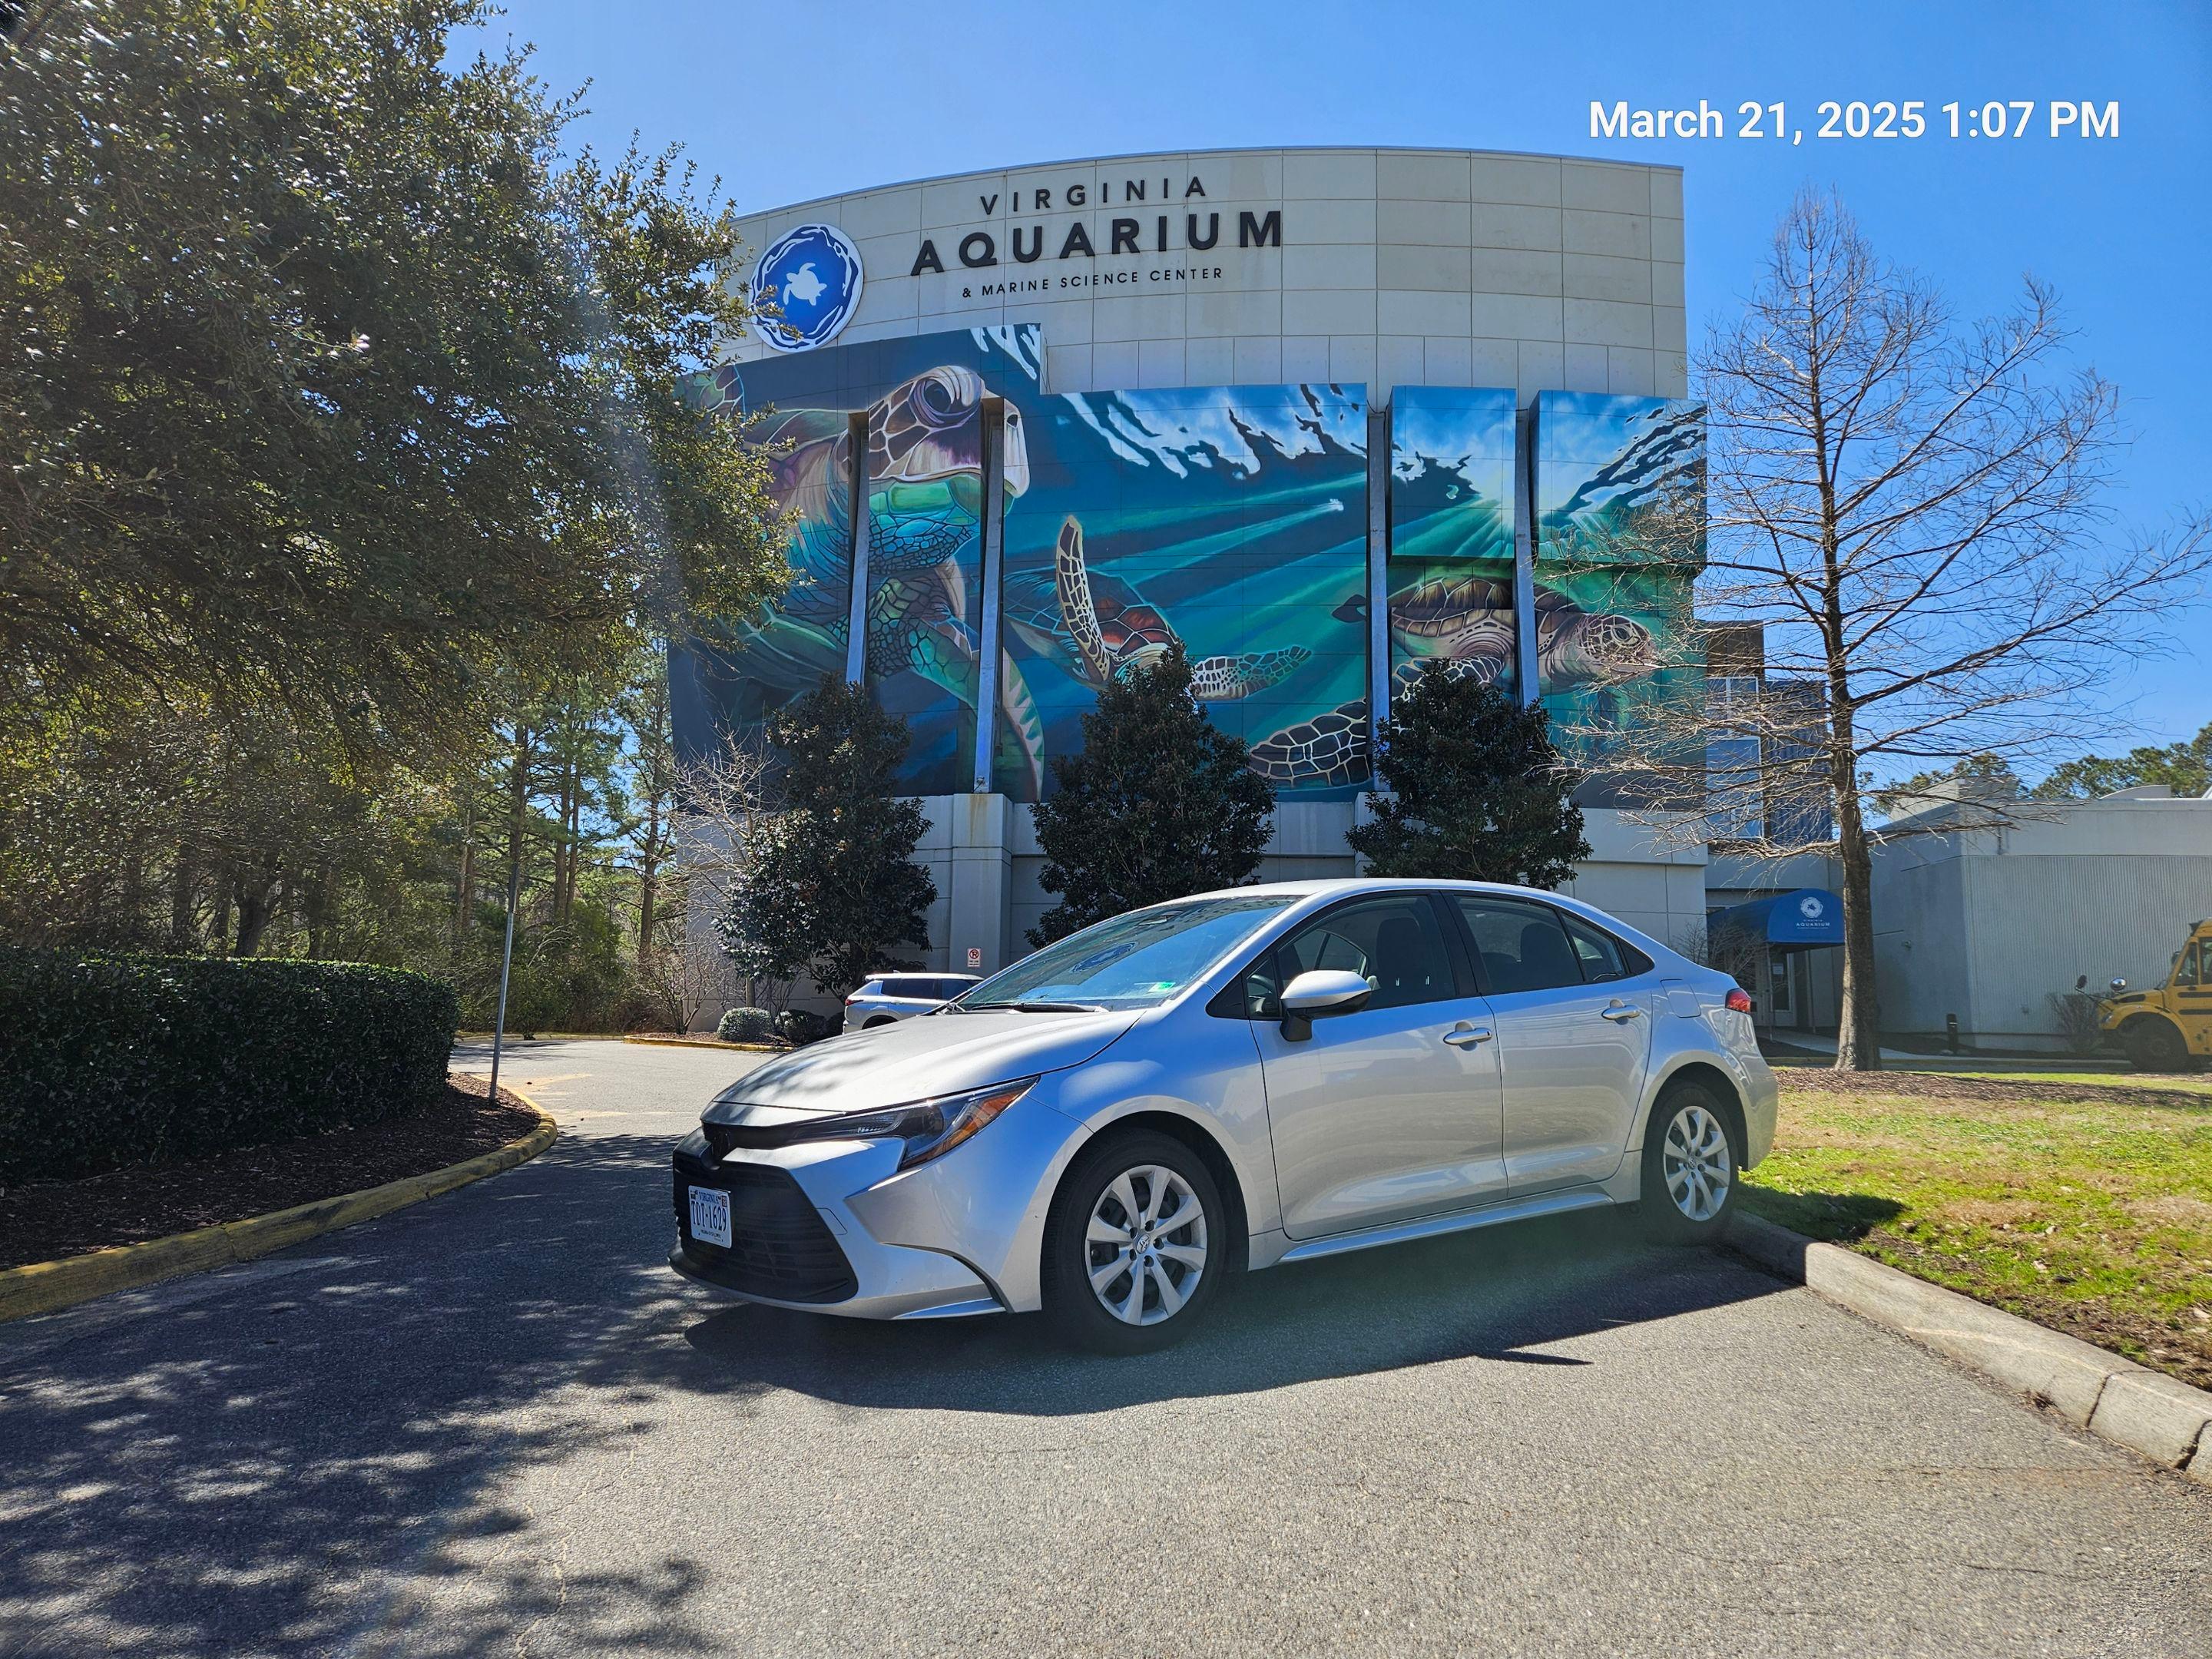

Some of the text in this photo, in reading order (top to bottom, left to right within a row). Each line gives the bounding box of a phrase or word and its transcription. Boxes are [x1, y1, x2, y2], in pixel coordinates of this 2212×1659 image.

[980, 176, 1206, 215] VIRGINIA
[910, 210, 1281, 276] AQUARIUM
[962, 267, 1222, 298] & MARINE SCIENCE CENTER
